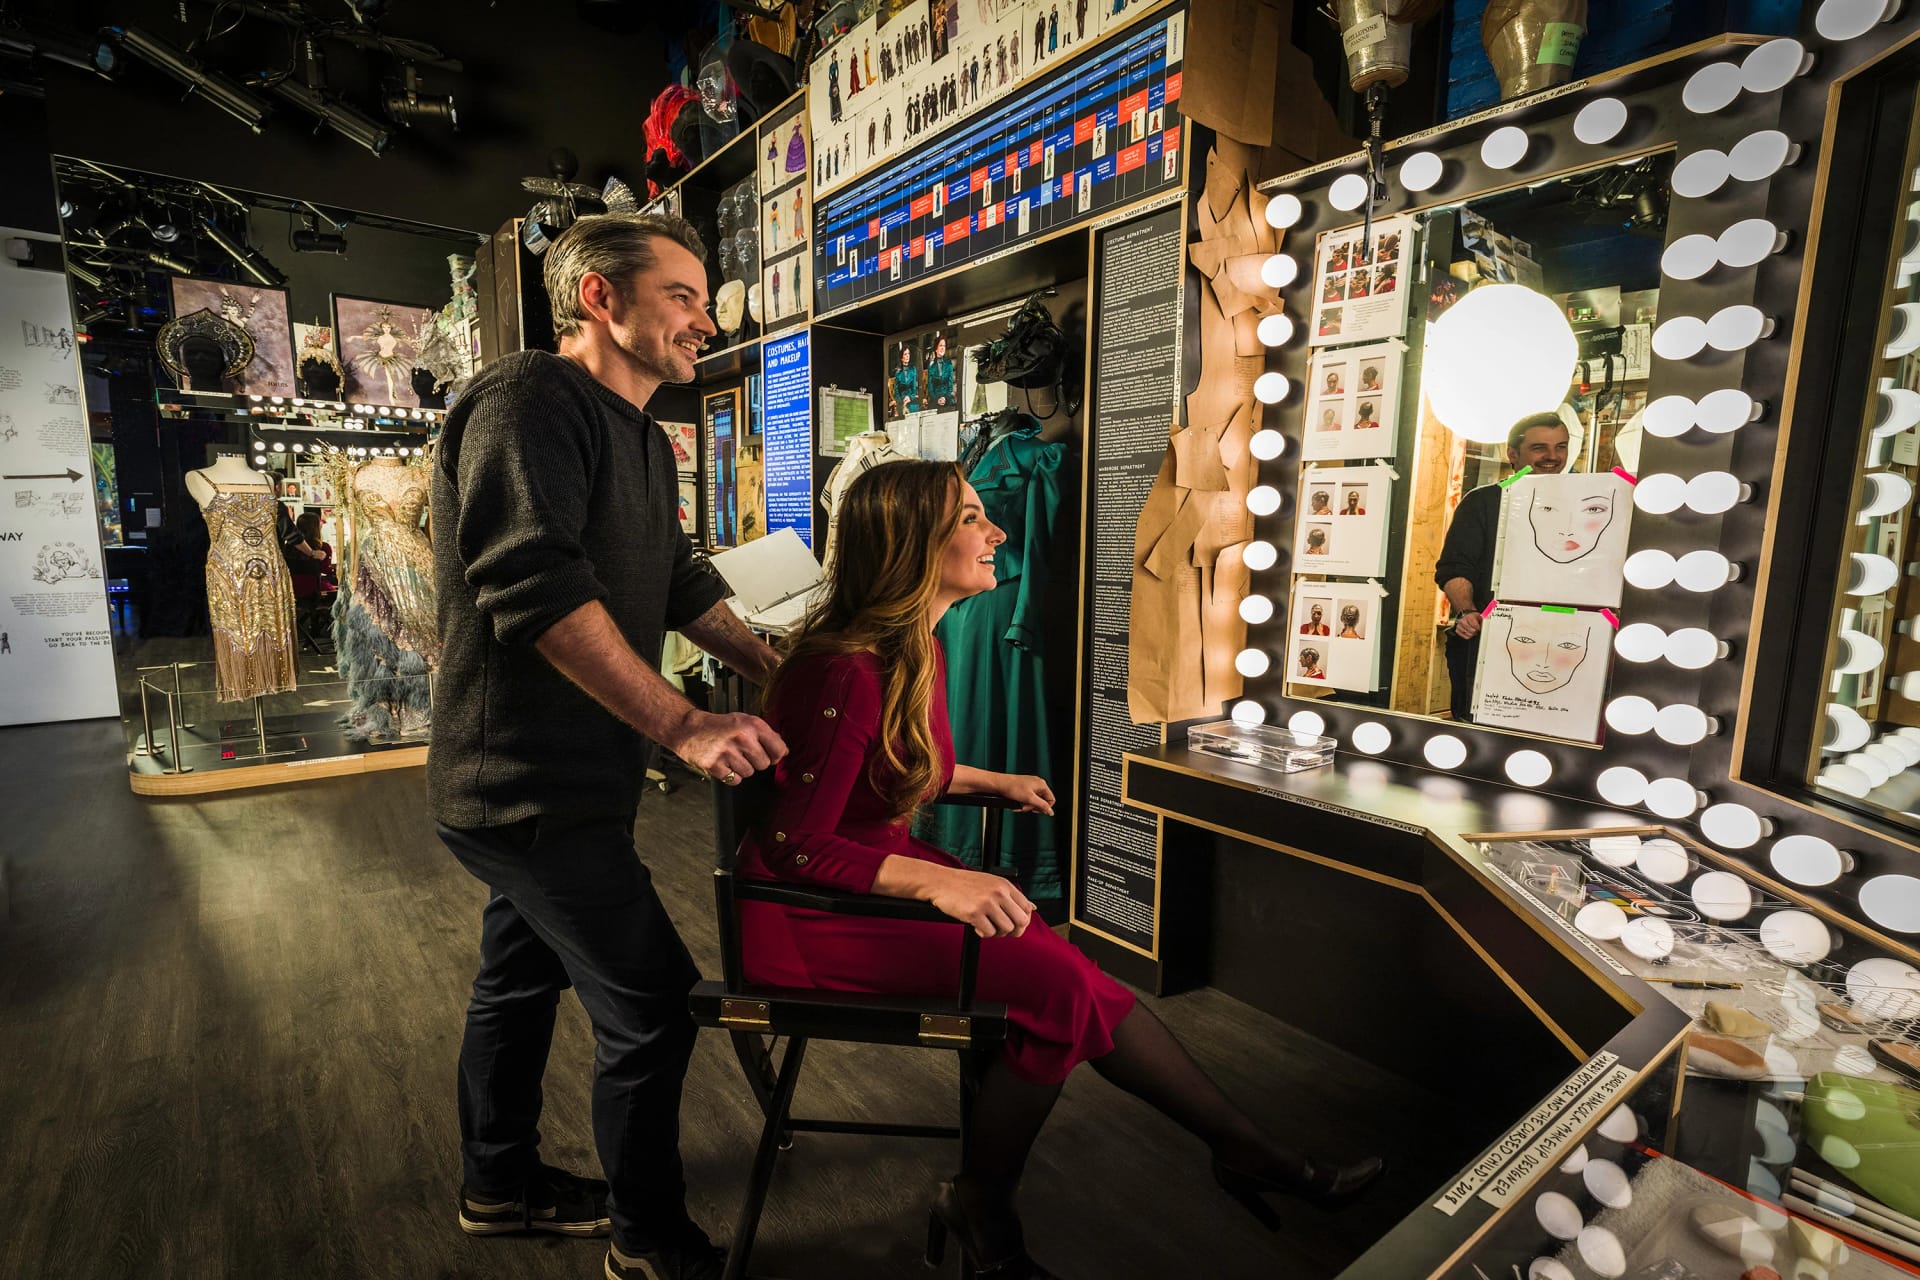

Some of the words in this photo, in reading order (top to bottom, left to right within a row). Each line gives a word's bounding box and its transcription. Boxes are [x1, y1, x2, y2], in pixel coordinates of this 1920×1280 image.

[767, 341, 796, 358] COSTUMES,
[767, 358, 779, 369] AND
[780, 351, 801, 366] MAKEUP
[1561, 1071, 1593, 1097] POTTER
[1601, 1070, 1628, 1094] CAROLE
[1548, 1096, 1567, 1112] AND
[1530, 1108, 1552, 1127] THE
[1499, 1122, 1536, 1155] CURSED
[1491, 1153, 1540, 1197] DESIGNER
[1444, 1180, 1473, 1205] 2018
